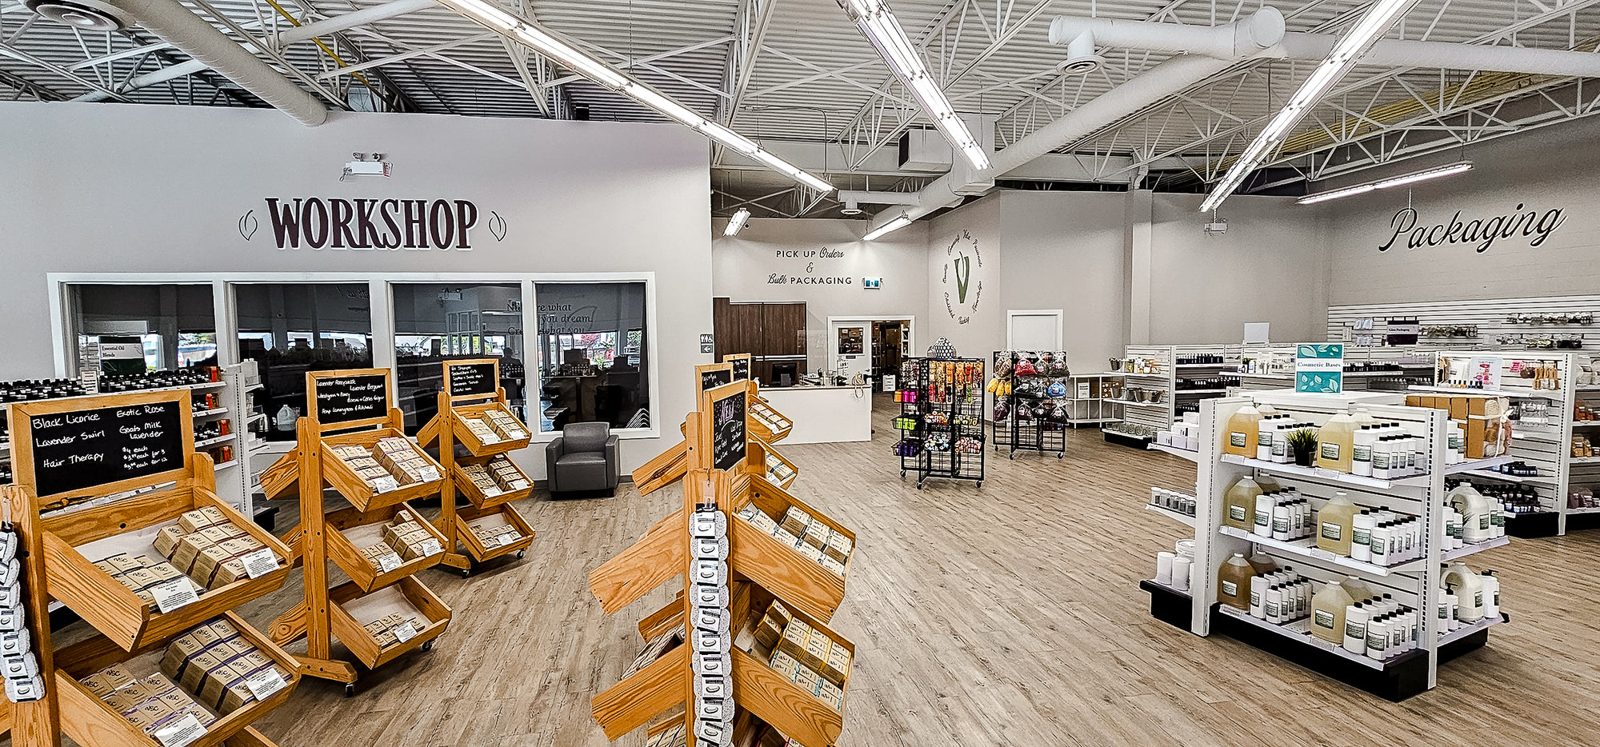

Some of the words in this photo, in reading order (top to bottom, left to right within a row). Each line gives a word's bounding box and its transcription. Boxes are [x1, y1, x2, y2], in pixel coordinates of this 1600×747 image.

[264, 197, 478, 250] WORKSHOP
[1378, 203, 1567, 253] Packaging
[776, 250, 799, 258] PICK
[803, 250, 816, 258] UP
[819, 246, 845, 259] Orders
[806, 261, 814, 273] &
[767, 273, 788, 285] Bulk
[790, 277, 852, 285] PACKAGING
[548, 302, 572, 312] what
[542, 314, 559, 327] you
[117, 409, 142, 417] Exotic
[144, 405, 165, 414] Rose
[32, 418, 63, 429] Black
[66, 413, 100, 424] Licorice
[120, 425, 140, 434] Goats
[36, 436, 76, 447] Lavender
[80, 430, 105, 440] Swirl
[44, 458, 65, 468] Hair
[68, 453, 104, 464] Therapy
